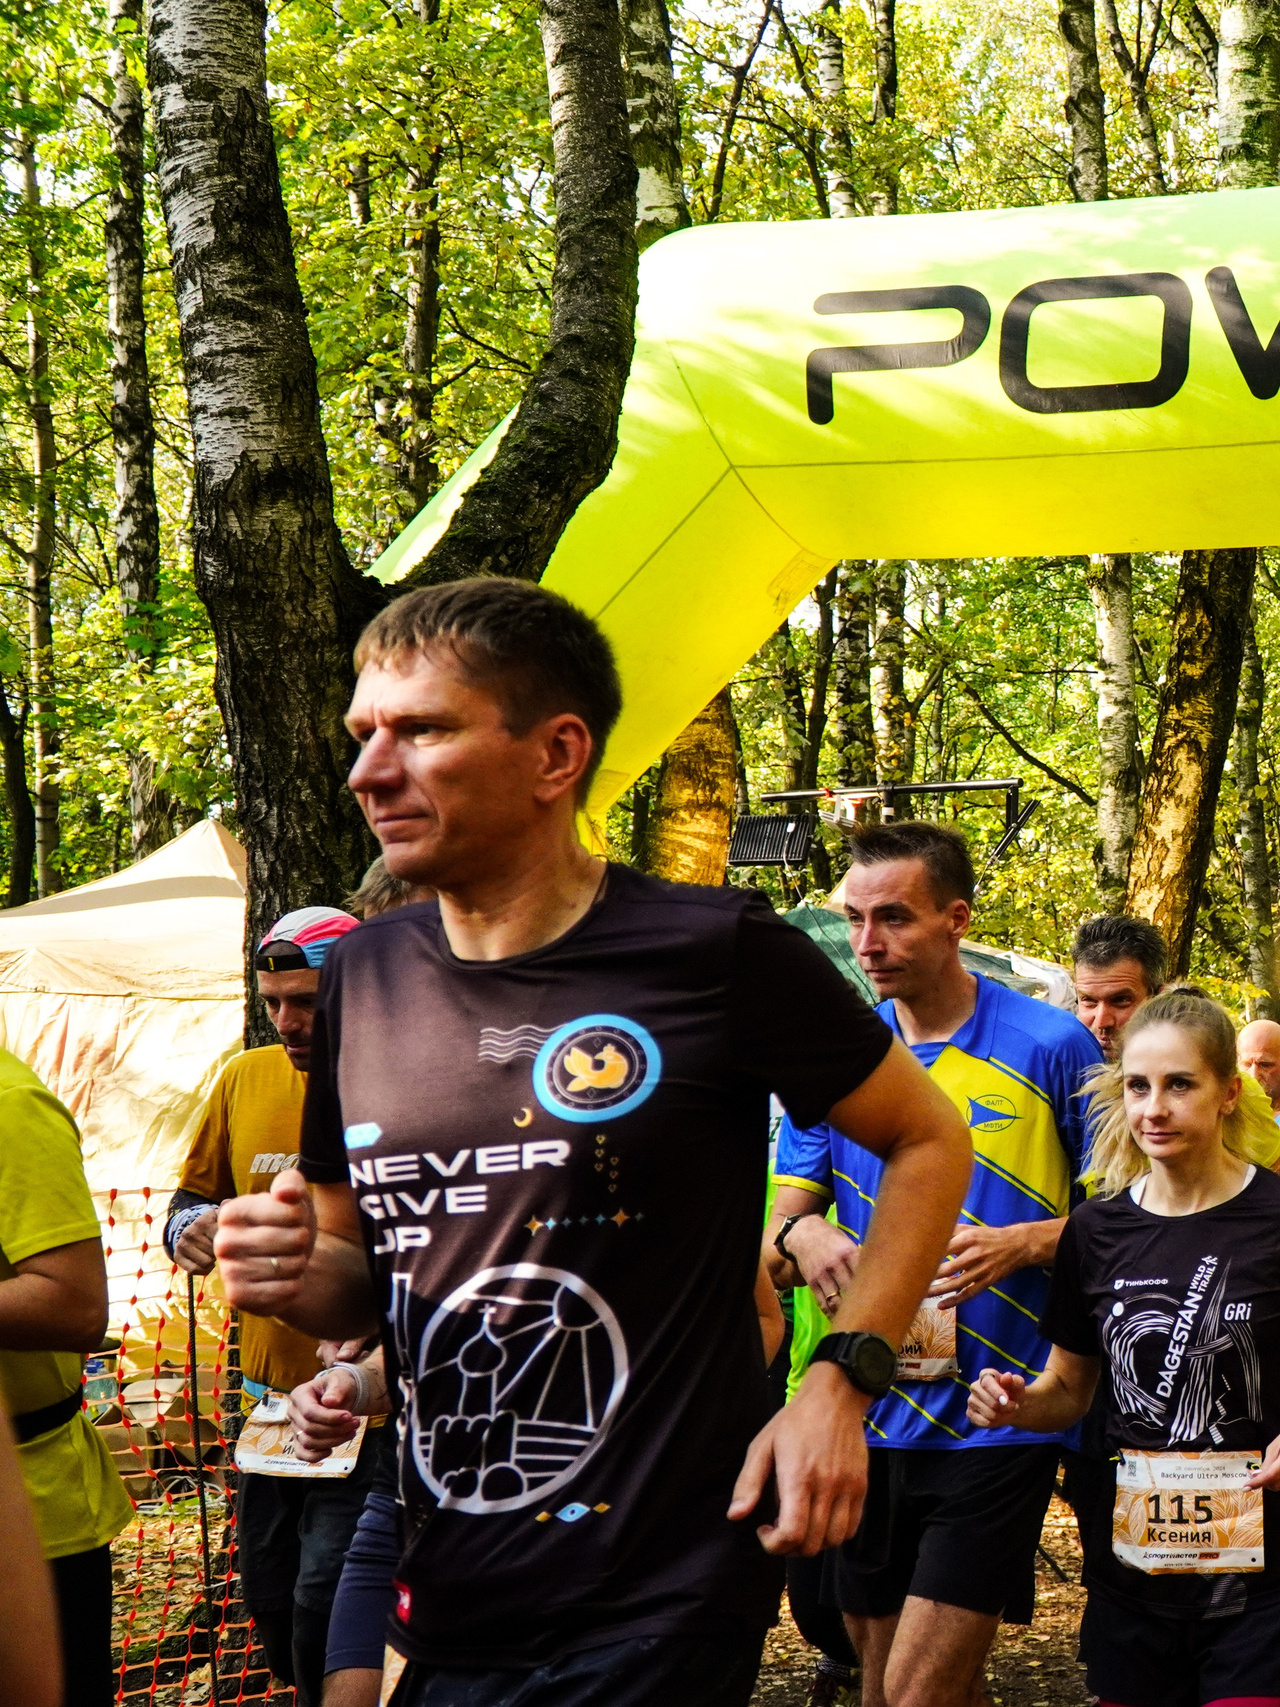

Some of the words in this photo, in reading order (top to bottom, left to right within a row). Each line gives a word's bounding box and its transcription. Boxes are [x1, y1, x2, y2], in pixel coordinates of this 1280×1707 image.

[348, 1139, 571, 1188] NEVER
[359, 1184, 488, 1220] GIVE
[1125, 1278, 1169, 1288] ТИНЬКОФФ
[1189, 1264, 1206, 1291] WILD
[1197, 1265, 1216, 1293] TRAIL
[1156, 1291, 1204, 1398] DAGESTAN
[1161, 1472, 1194, 1480] Backyard
[1147, 1494, 1213, 1524] 115
[1147, 1527, 1212, 1543] Ксения
